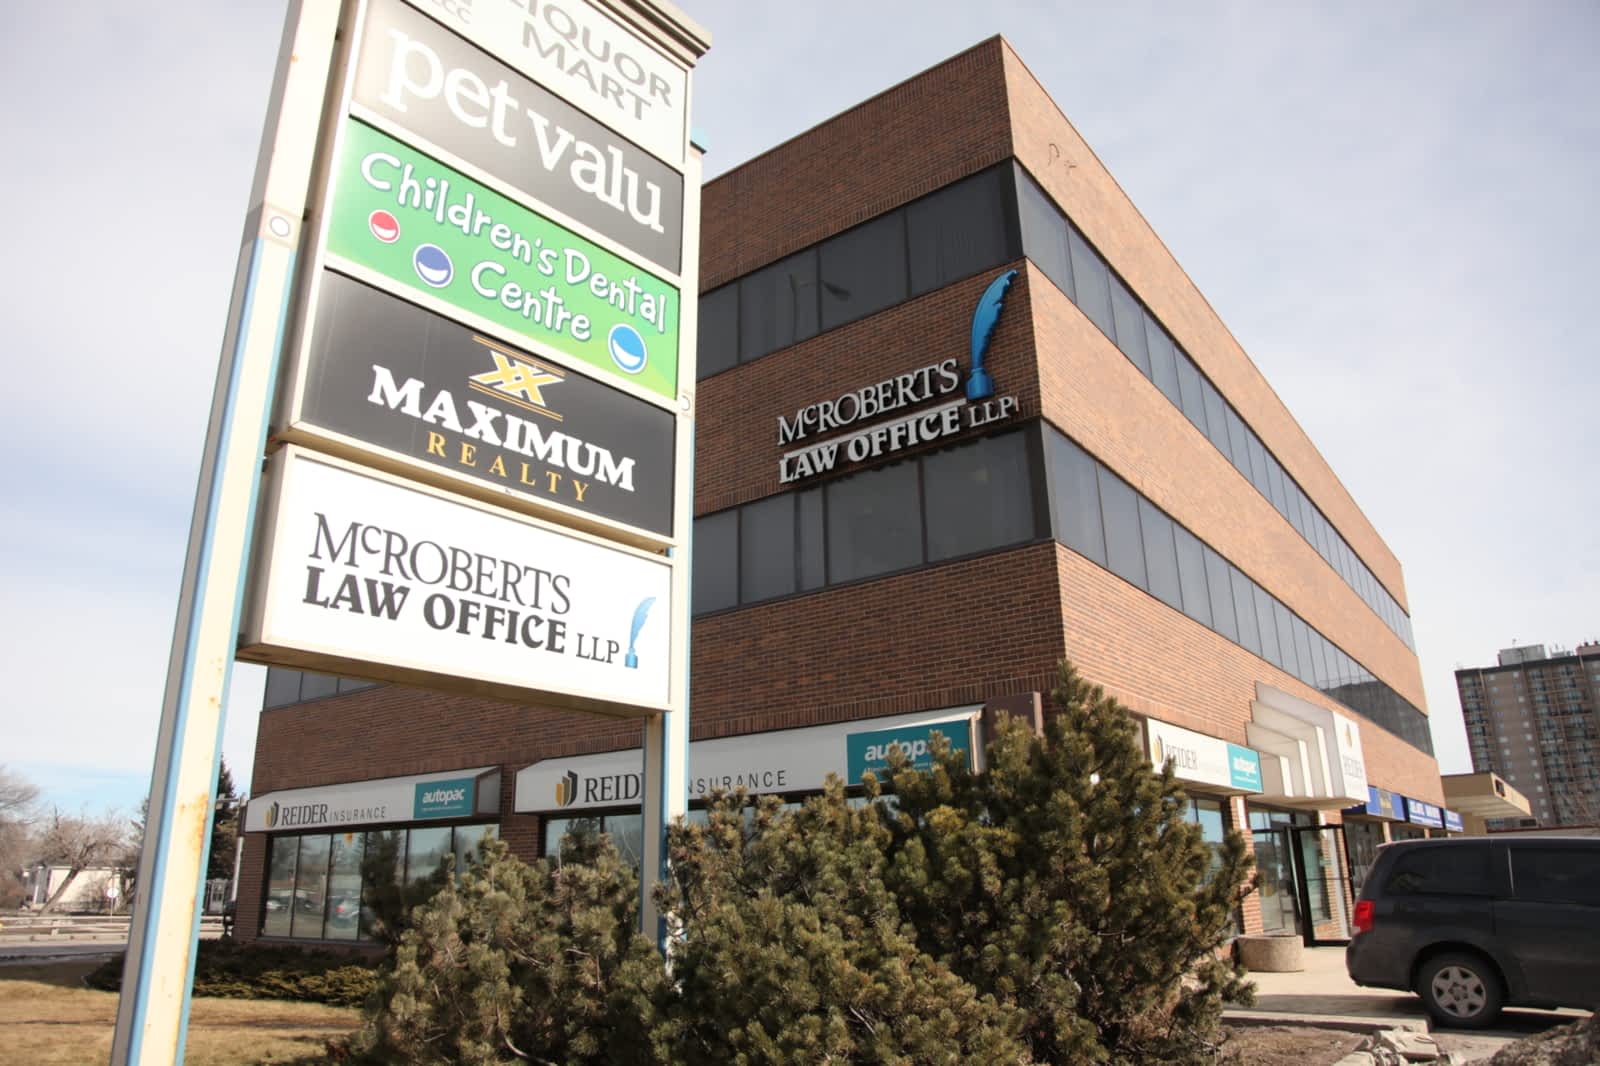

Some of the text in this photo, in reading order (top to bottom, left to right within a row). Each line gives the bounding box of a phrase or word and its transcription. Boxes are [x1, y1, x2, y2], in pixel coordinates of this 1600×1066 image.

[522, 20, 652, 121] MART
[380, 27, 665, 233] pet valu
[360, 152, 667, 333] Children's Dental
[471, 260, 592, 341] Centre
[367, 363, 636, 493] MAXIMUM
[426, 430, 590, 503] REALTY
[778, 396, 1014, 485] LAW OFFICE LLP
[302, 565, 621, 665] LAW OFFICE LLP
[280, 803, 386, 826] REIDER INSURANCE
[422, 788, 465, 805] autopac
